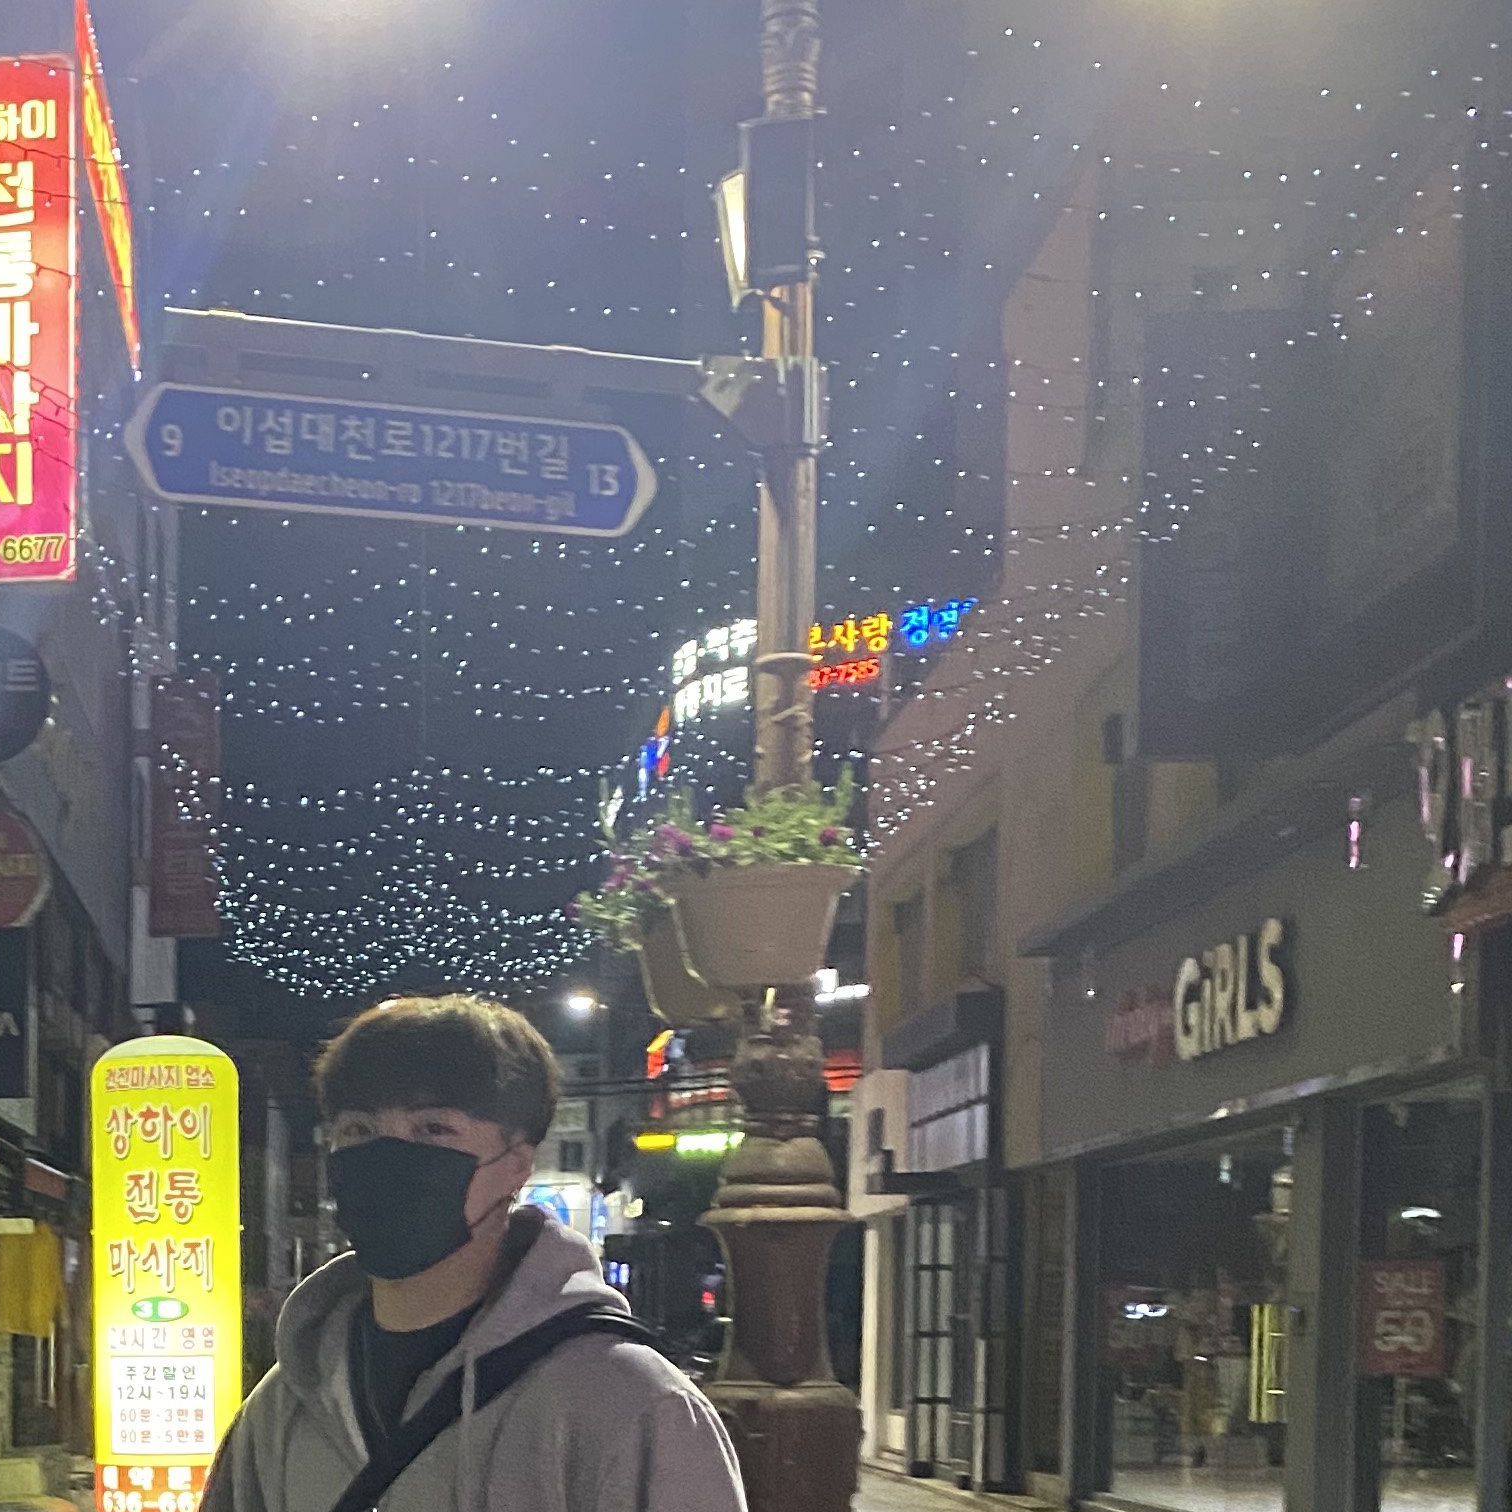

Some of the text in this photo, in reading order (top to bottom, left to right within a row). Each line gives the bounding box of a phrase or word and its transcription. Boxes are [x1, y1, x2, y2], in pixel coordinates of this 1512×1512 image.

[159, 424, 183, 457] 9
[216, 404, 570, 482] 이섭대천로1217번길
[586, 463, 621, 497] 13
[105, 1103, 213, 1160] 상하이
[124, 1170, 203, 1223] 전통
[108, 1237, 214, 1294] 마사지
